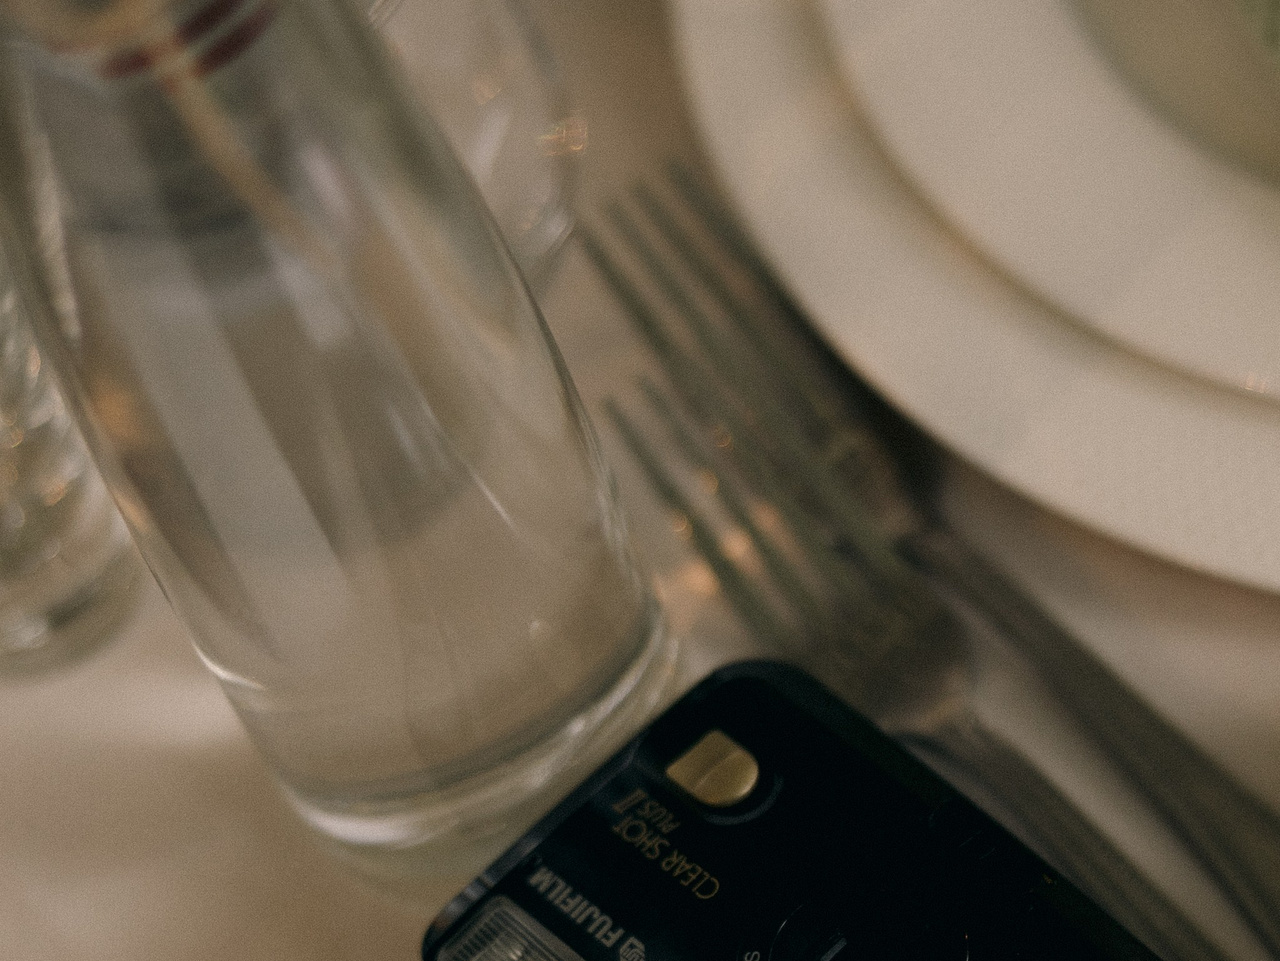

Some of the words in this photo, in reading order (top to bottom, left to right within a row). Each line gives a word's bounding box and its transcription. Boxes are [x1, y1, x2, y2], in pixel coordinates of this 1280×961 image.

[611, 815, 671, 860] SHOT
[637, 800, 682, 834] PLUS
[661, 850, 720, 900] CLEAR
[527, 866, 626, 949] FUJIFILM
